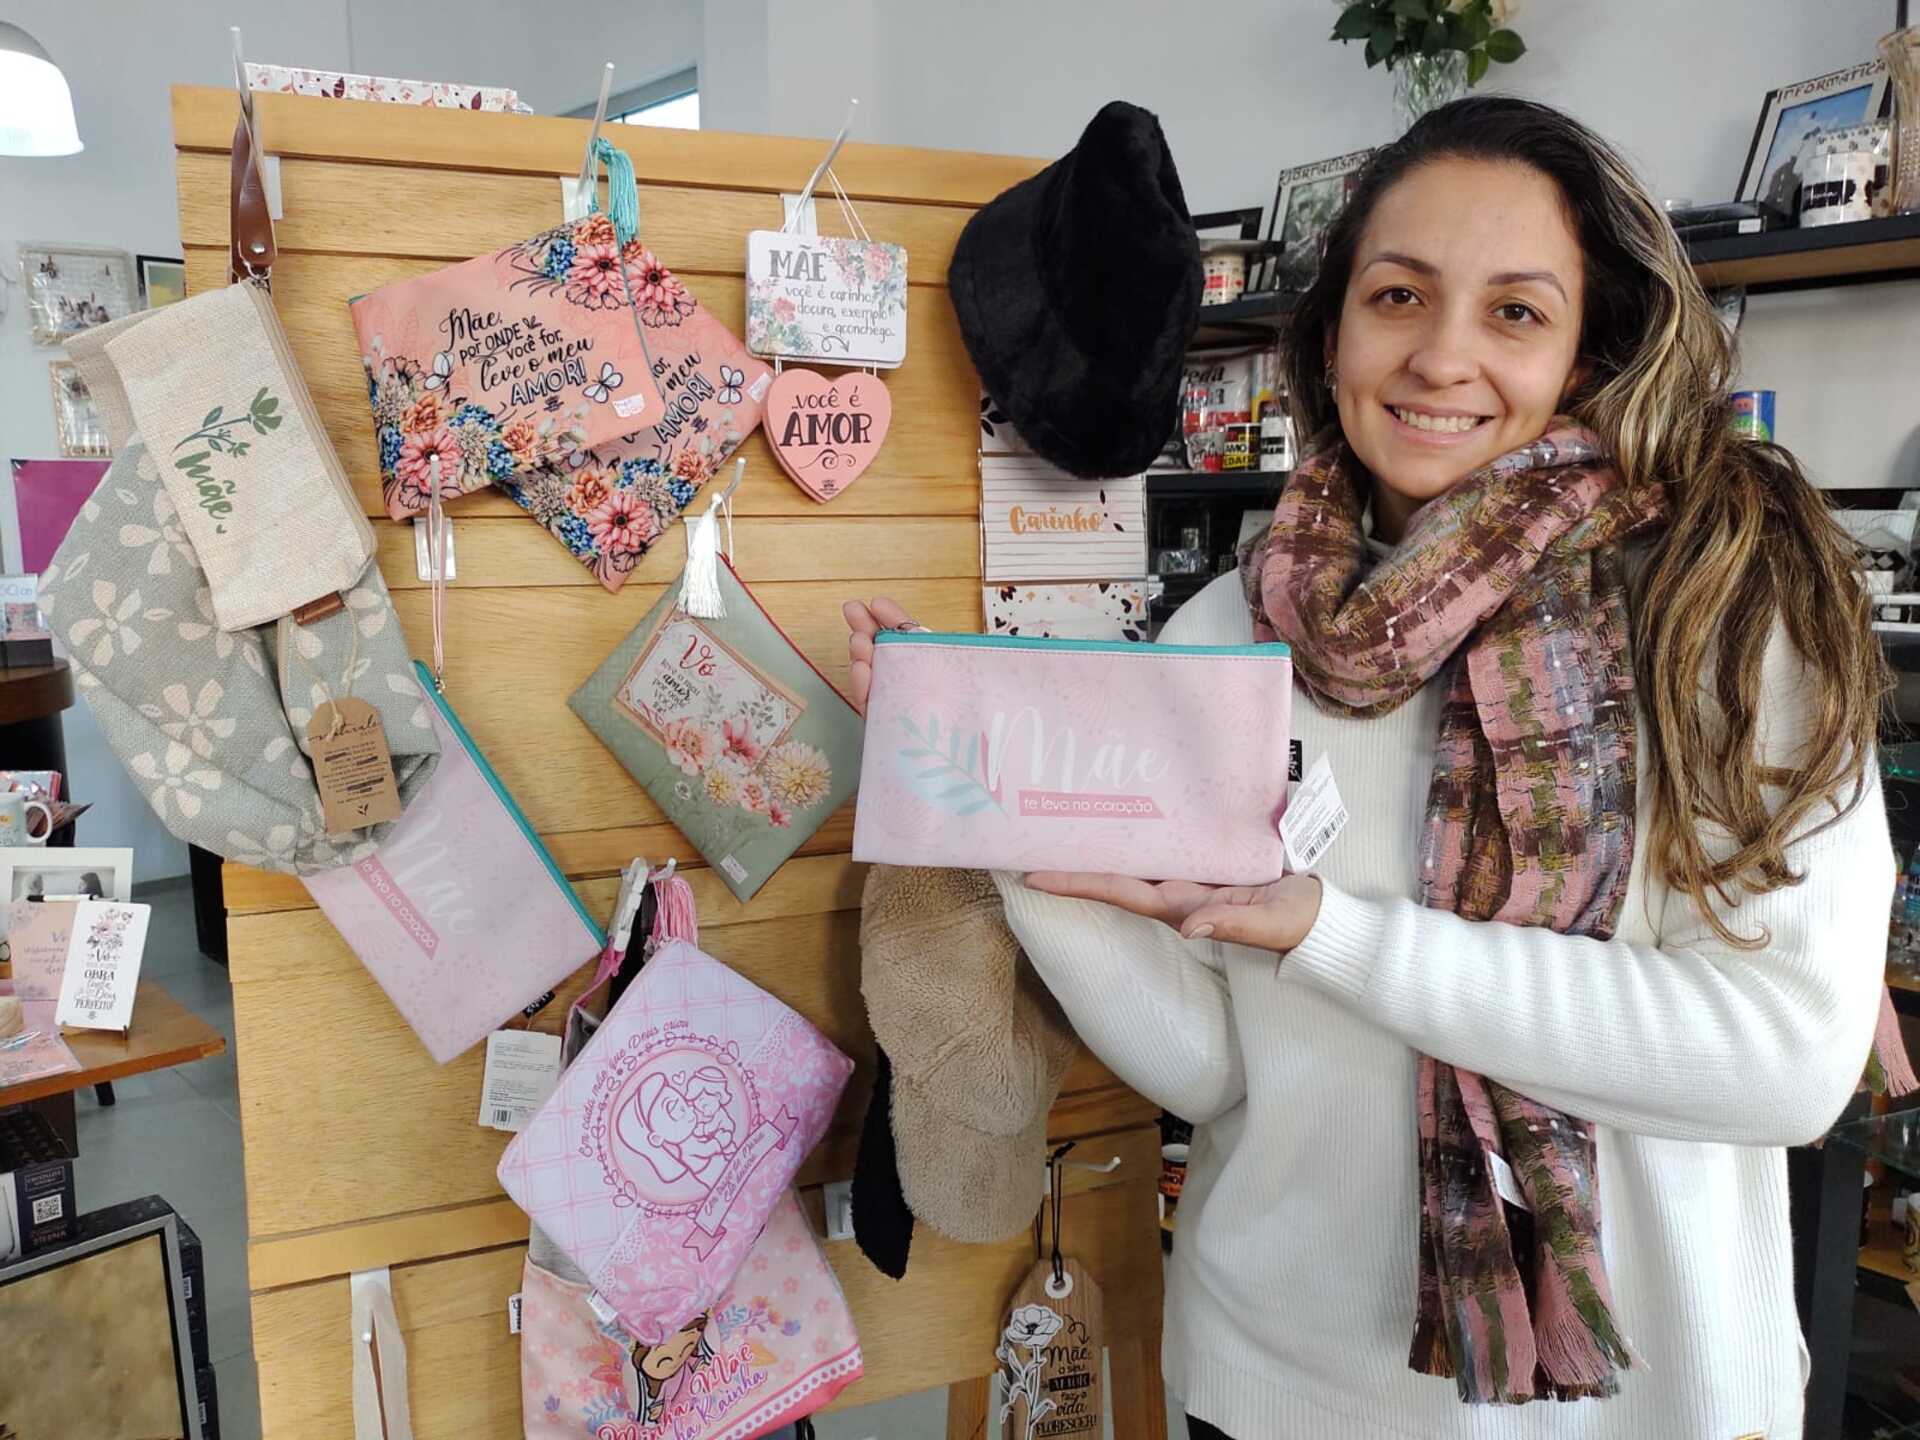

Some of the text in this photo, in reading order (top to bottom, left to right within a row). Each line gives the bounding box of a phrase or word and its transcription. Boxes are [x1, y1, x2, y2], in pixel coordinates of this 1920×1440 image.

[768, 244, 828, 282] MÃE
[785, 286, 813, 299] você
[817, 284, 826, 299] é
[459, 323, 523, 366] por ONDE
[822, 323, 830, 332] e
[480, 337, 595, 392] leve o meu
[506, 335, 537, 360] você
[511, 356, 587, 406] AMOR!
[666, 352, 702, 391] meu
[653, 372, 716, 444] AMOR!
[849, 385, 862, 408] é
[779, 411, 872, 447] AMOR
[1009, 505, 1103, 535] Carinho
[987, 705, 1169, 793] Mãe
[1024, 795, 1153, 815] te leva no coração
[628, 1026, 660, 1049] Deus
[689, 1344, 750, 1395] Mãe
[696, 1363, 768, 1423] Rainha
